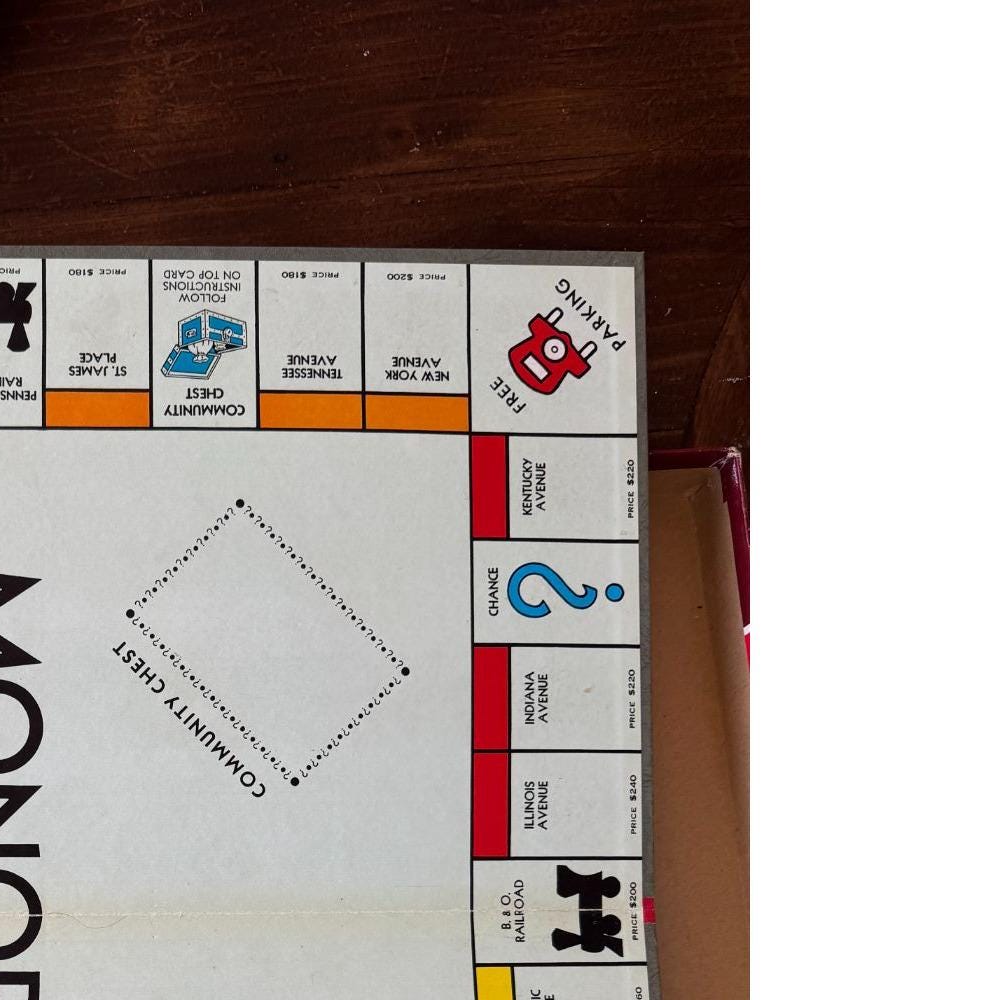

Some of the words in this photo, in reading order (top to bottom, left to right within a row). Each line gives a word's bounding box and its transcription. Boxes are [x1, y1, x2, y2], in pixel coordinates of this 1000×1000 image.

[164, 270, 194, 279] CARD
[199, 271, 219, 279] TOP
[224, 271, 240, 280] ON
[312, 271, 339, 279] PRICE
[163, 281, 240, 291] INSTRUCTIONS
[179, 293, 225, 303] FOLLOW
[555, 278, 627, 352] PARKING
[79, 353, 116, 363] PLACE
[287, 355, 337, 365] AVENUE
[392, 357, 441, 368] AVENUE
[69, 366, 108, 376] JAMES
[112, 366, 127, 376] ST.
[282, 368, 342, 379] TENNESSEE
[385, 370, 417, 380] YORK
[421, 371, 449, 381] NEW
[186, 388, 224, 399] CHEST
[489, 375, 527, 414] FREE
[164, 405, 245, 416] COMMUNITY
[522, 458, 532, 515] KENTUCKY
[536, 463, 545, 511] AVENUE
[627, 492, 635, 518] PRICE
[488, 568, 498, 616] CHANCE
[112, 641, 165, 693] CHEST
[525, 672, 534, 724] INDIANA
[538, 674, 548, 723] AVENUE
[628, 702, 636, 728] PRICE
[164, 696, 266, 798] COMMUNITY
[524, 782, 534, 829] ILLINOIS
[538, 781, 548, 830] AVENUE
[514, 880, 525, 942] RAILROAD
